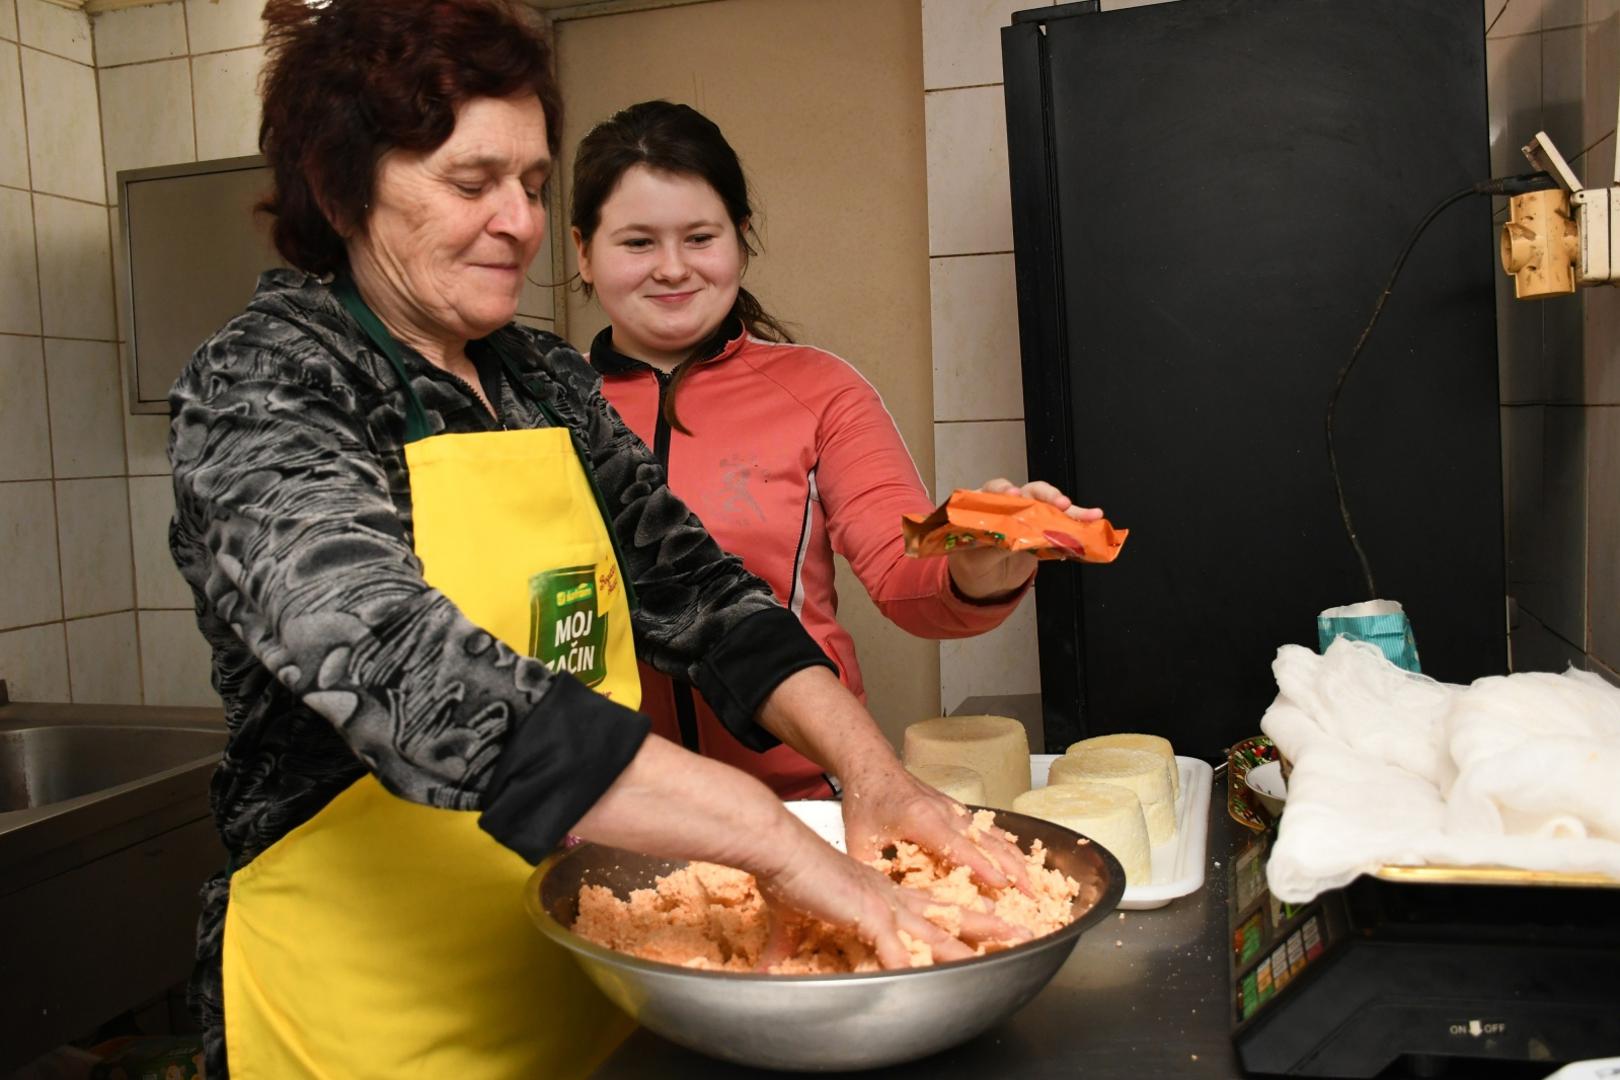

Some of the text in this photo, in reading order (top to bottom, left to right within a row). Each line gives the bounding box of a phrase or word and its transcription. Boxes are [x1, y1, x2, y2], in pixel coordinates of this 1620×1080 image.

[555, 610, 593, 647] MOJ
[1449, 1023, 1505, 1034] ON OFF
